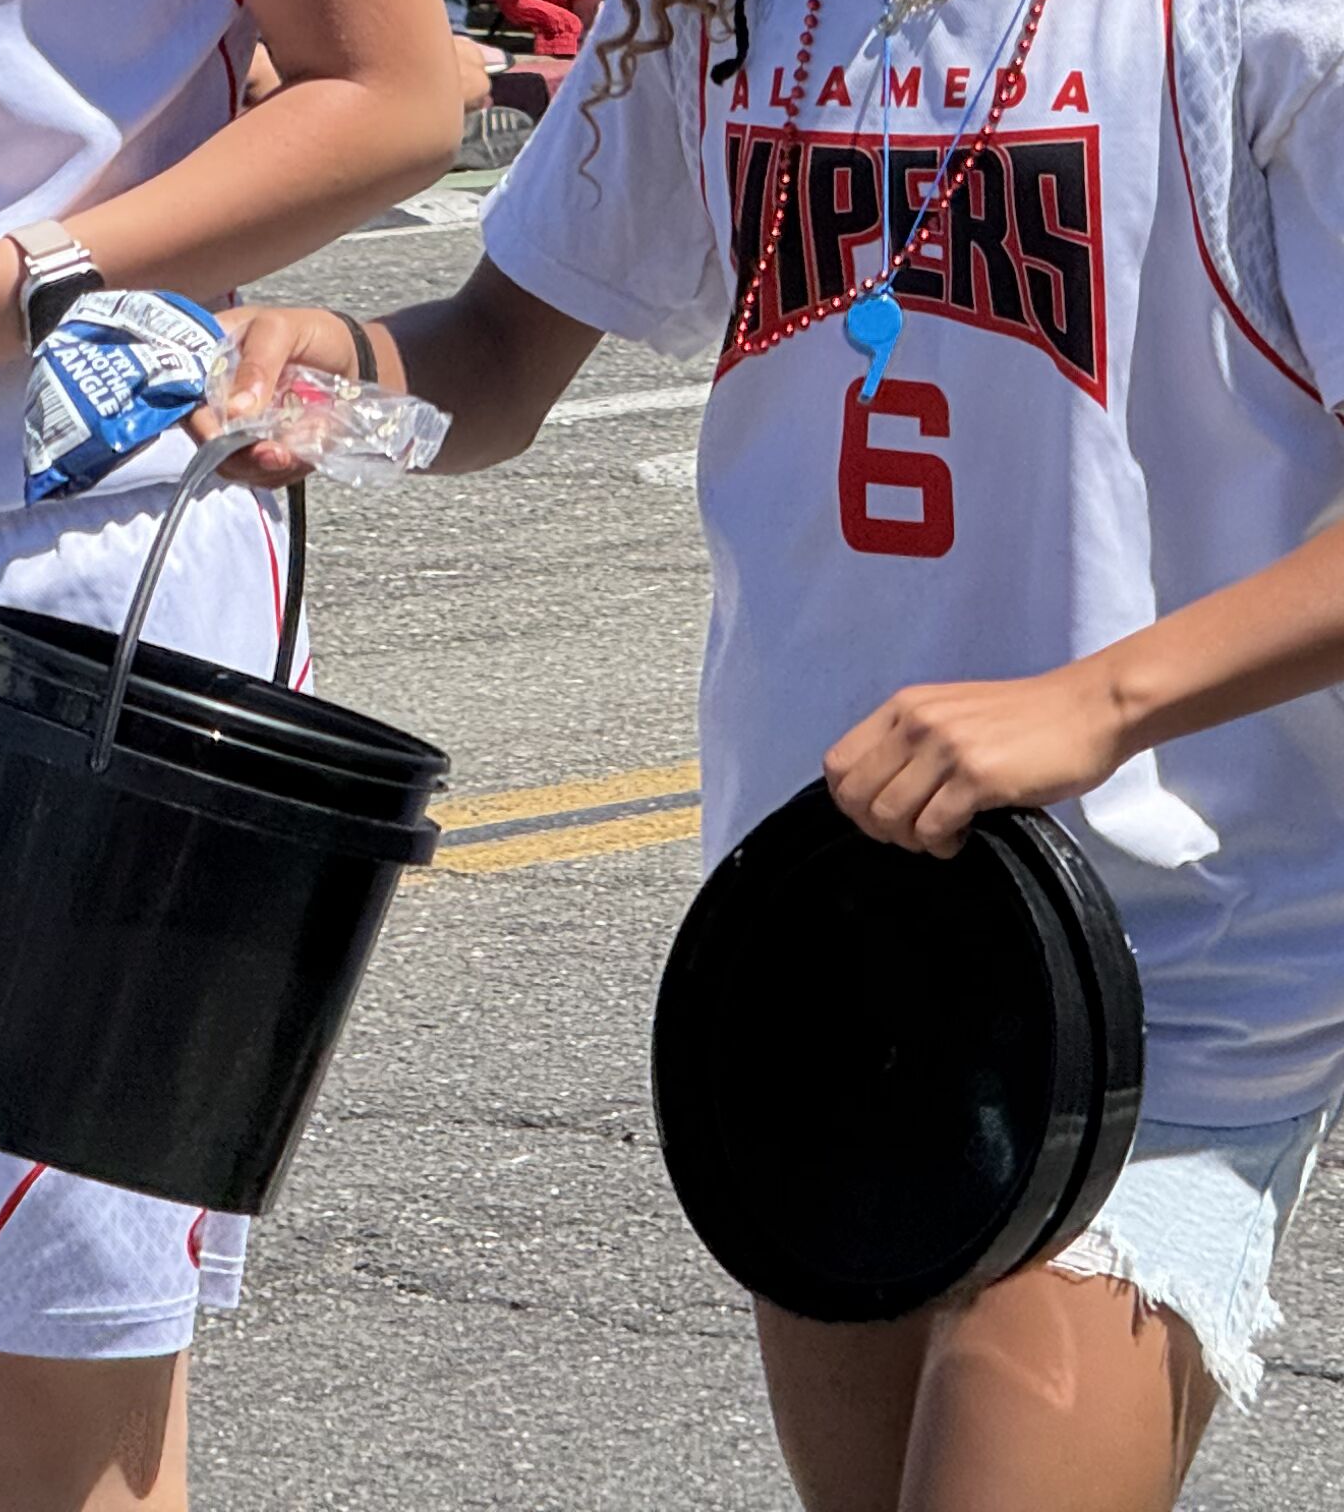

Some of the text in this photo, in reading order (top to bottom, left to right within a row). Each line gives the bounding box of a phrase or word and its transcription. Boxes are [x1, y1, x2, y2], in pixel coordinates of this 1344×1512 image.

[729, 65, 1090, 114] ALAMEDA
[713, 121, 1109, 414] VIPERS
[54, 348, 120, 418] ANGLE
[106, 348, 141, 379] TRY
[838, 376, 955, 559] 6
